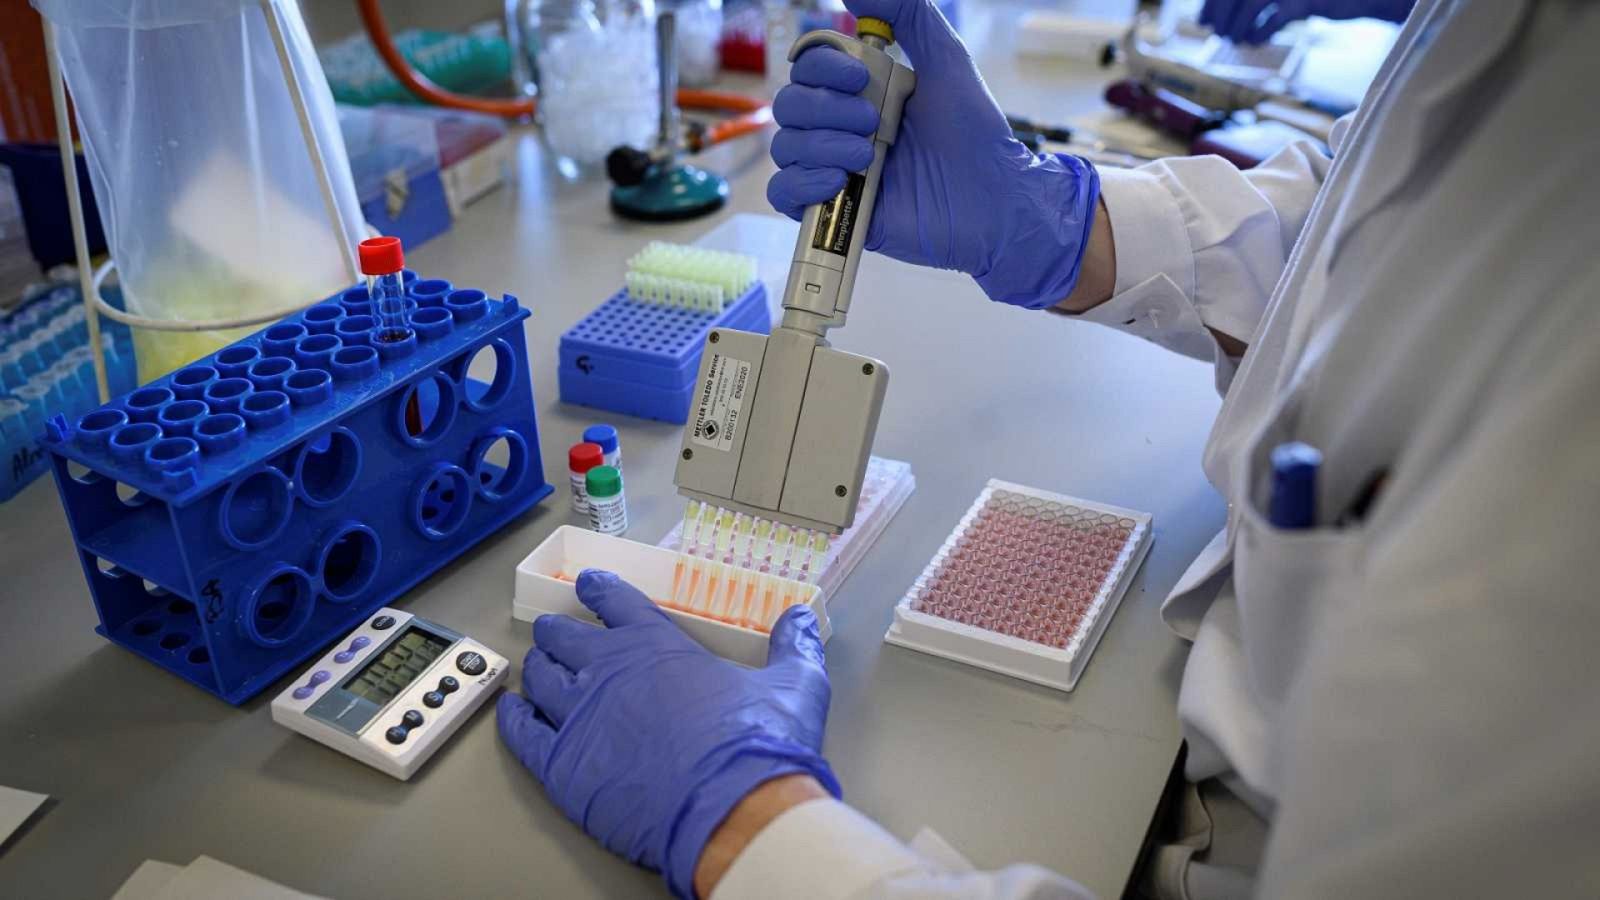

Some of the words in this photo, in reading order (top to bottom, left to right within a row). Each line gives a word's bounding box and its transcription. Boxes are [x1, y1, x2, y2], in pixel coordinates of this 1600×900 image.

[694, 408, 706, 437] METTLER
[702, 380, 713, 406] TOLEDO
[709, 354, 719, 379] Service
